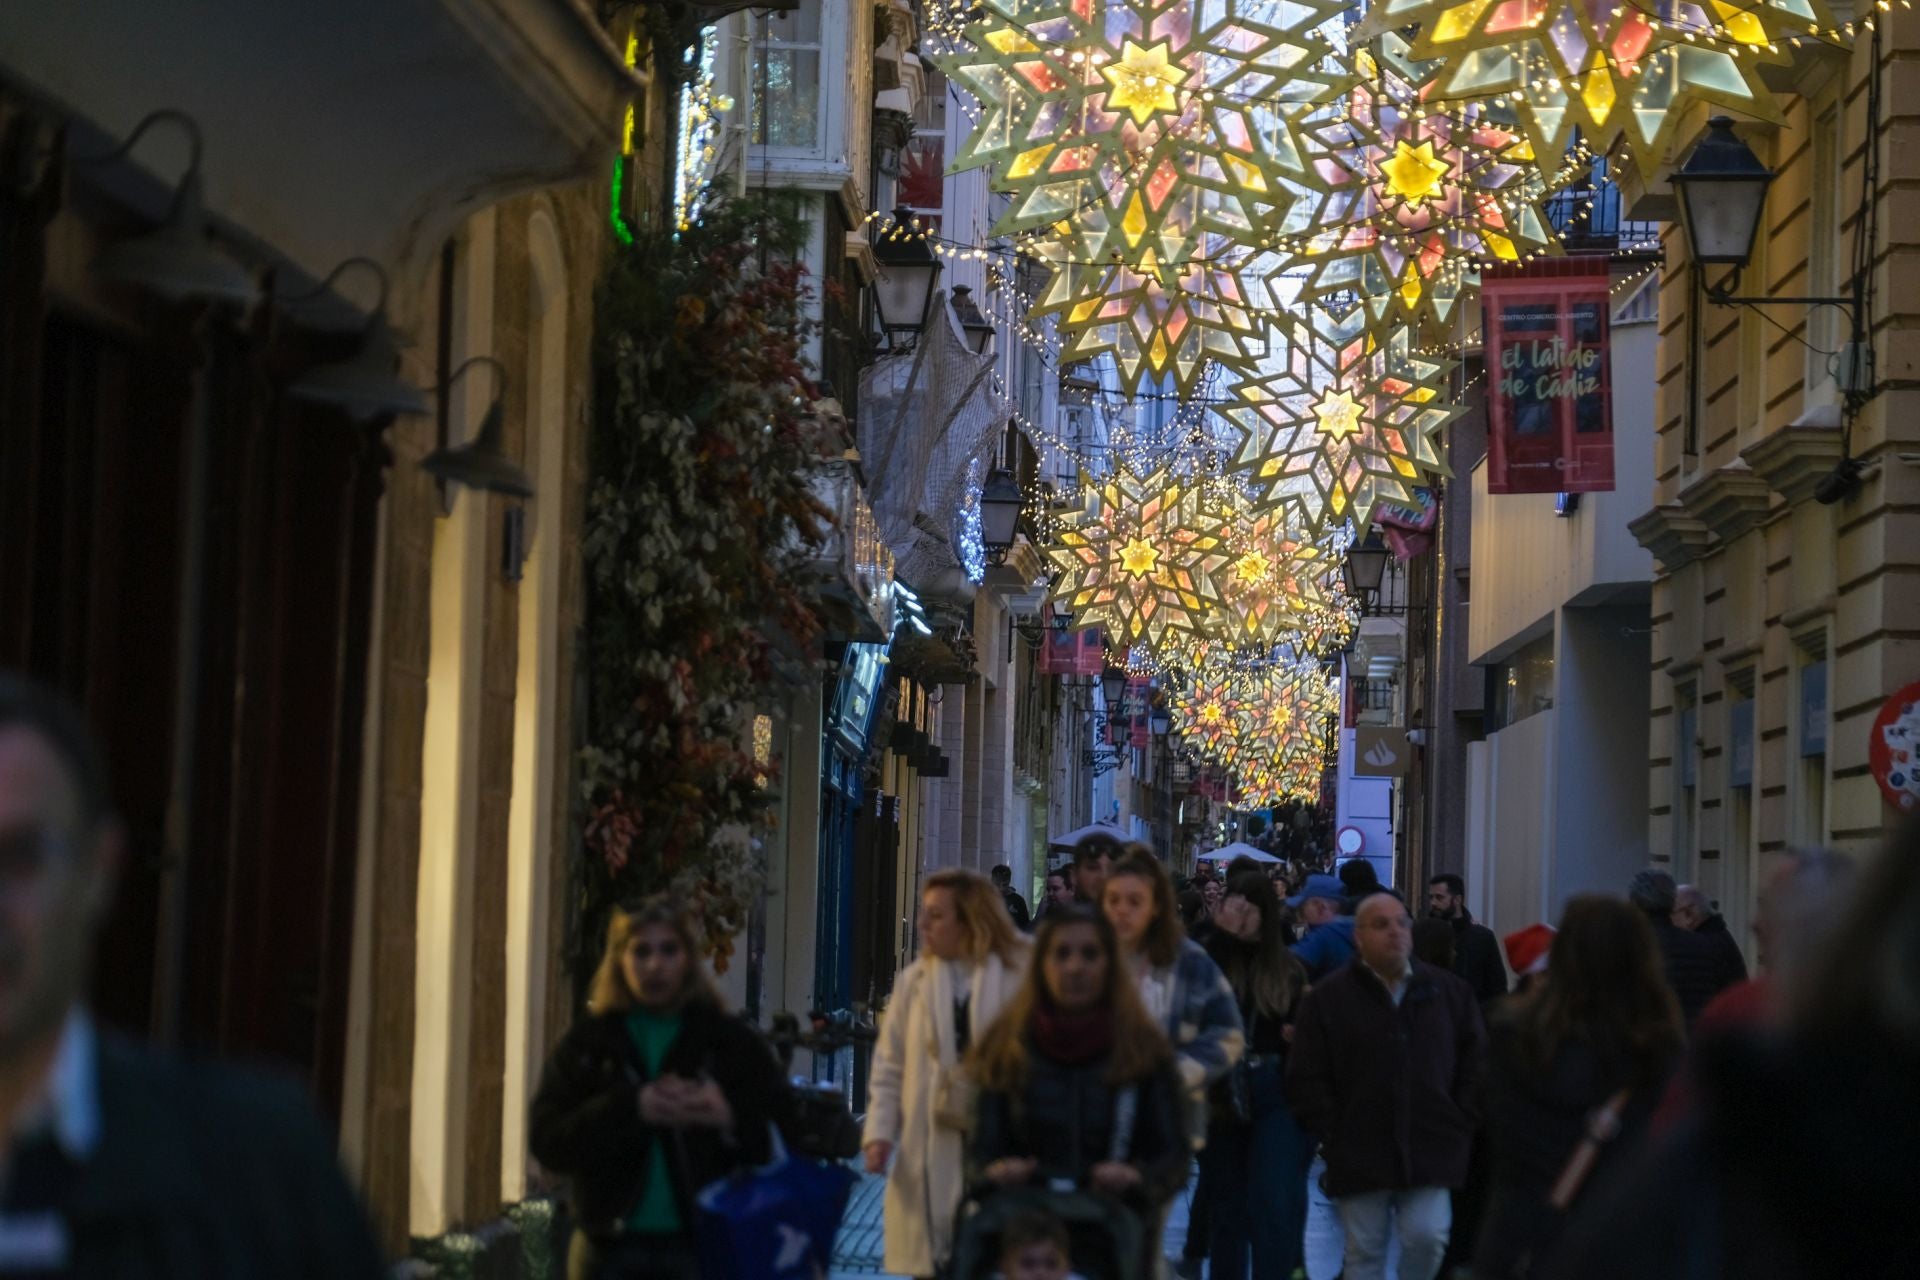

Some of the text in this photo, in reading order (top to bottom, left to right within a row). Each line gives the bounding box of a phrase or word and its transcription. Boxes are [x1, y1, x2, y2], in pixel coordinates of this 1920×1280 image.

[1502, 335, 1598, 369] El latido
[1498, 370, 1600, 400] de Cádiz
